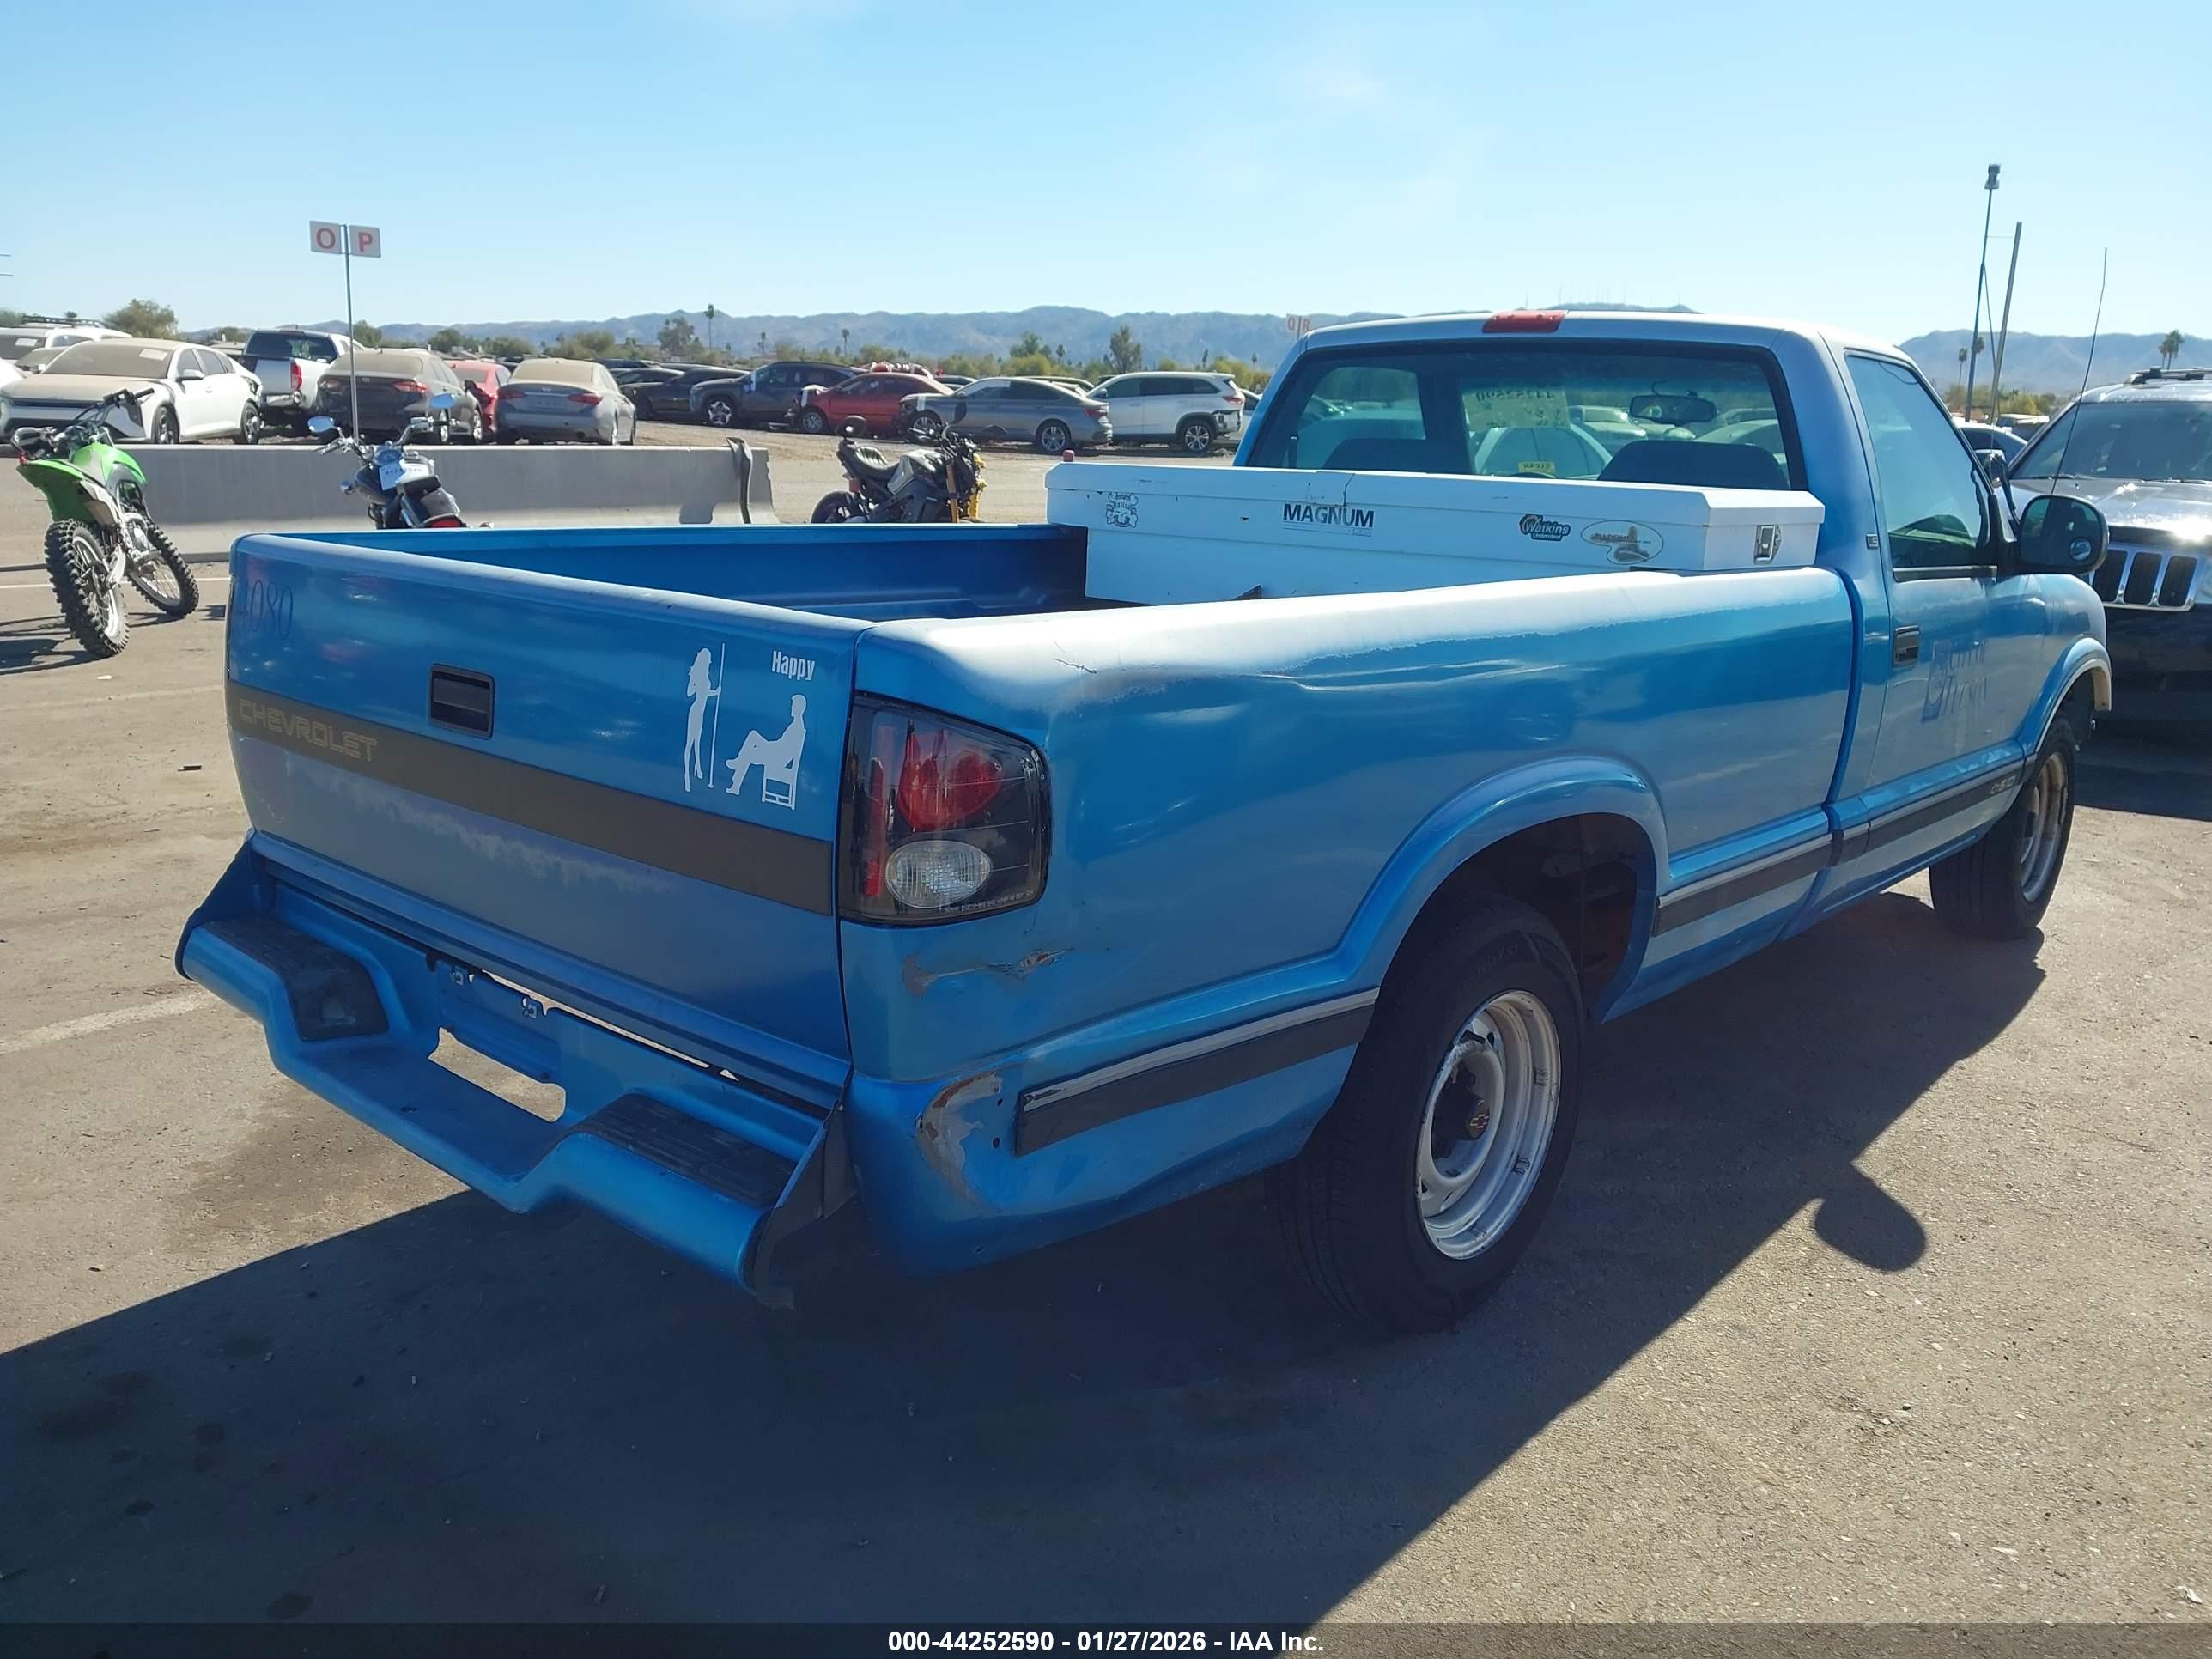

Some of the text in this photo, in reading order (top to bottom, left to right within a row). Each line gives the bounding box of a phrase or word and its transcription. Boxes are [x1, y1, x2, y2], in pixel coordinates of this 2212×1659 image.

[316, 228, 336, 249] O
[358, 232, 373, 252] P
[1283, 503, 1375, 528] MAGNUM
[771, 650, 816, 681] Happy
[240, 698, 378, 763] CHEVROLET
